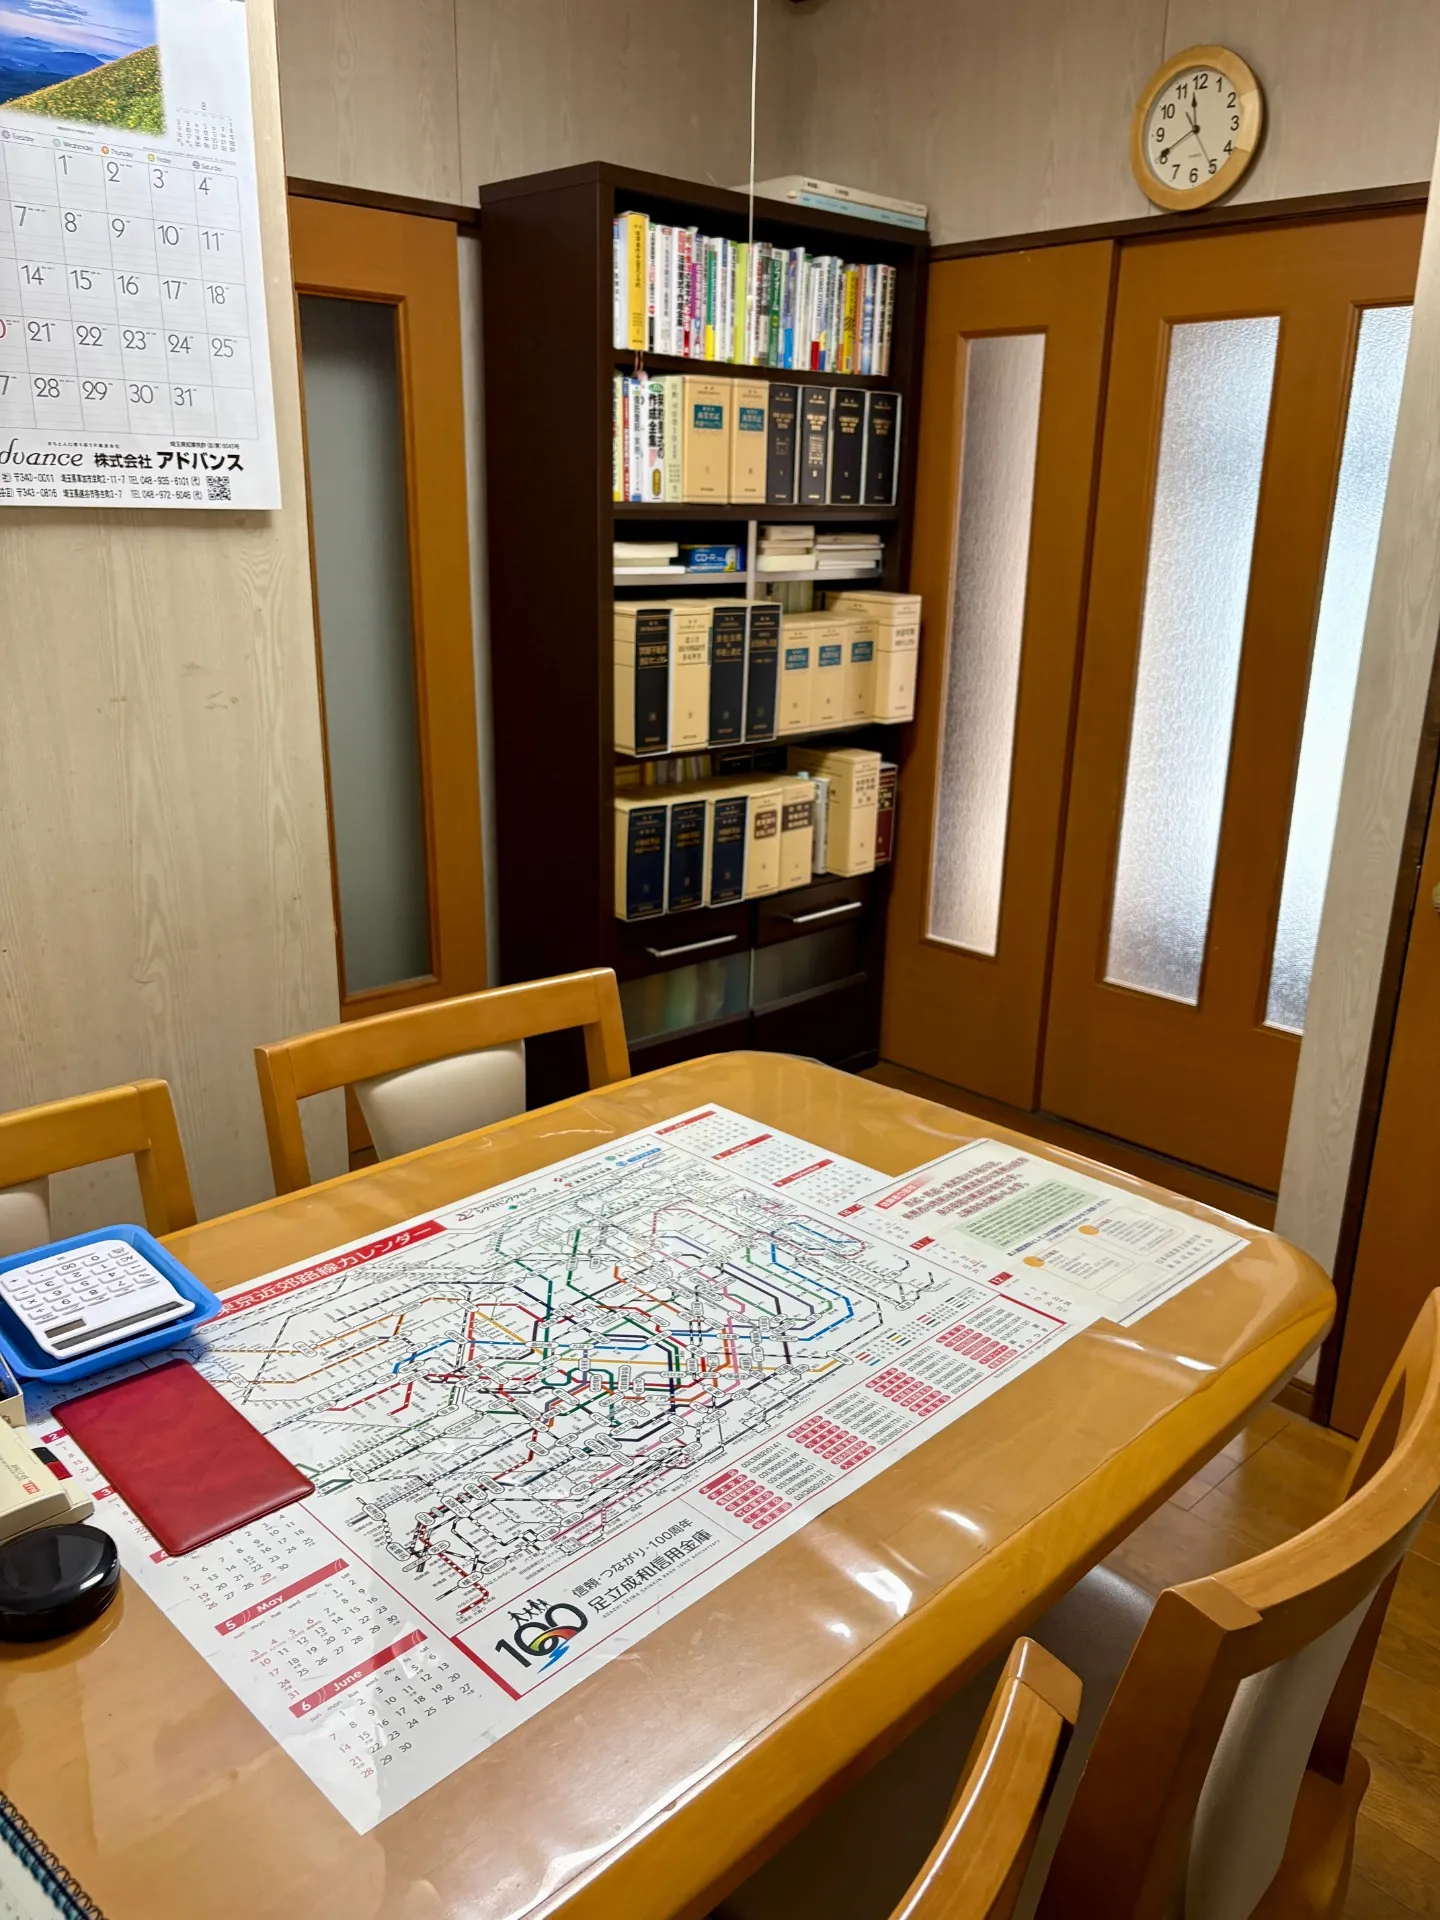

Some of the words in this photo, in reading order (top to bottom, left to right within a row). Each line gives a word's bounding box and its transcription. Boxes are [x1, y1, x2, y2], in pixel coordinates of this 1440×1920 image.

[1176, 83, 1188, 100] 11
[1192, 73, 1209, 90] 12
[1215, 77, 1223, 92] 1
[1227, 92, 1236, 108] 2
[1160, 103, 1175, 120] 10
[1230, 115, 1240, 131] 3
[1156, 127, 1165, 143] 9
[1223, 140, 1233, 155] 4
[58, 154, 68, 175] 1
[107, 161, 120, 183] 2
[153, 168, 165, 189] 3
[198, 177, 210, 196] 4
[1172, 164, 1180, 180] 7
[1189, 168, 1198, 183] 6
[1208, 158, 1218, 174] 5
[14, 205, 27, 227] 7
[64, 212, 78, 233] 8
[111, 218, 126, 238] 9
[157, 224, 180, 246] 10
[201, 231, 220, 251] 11
[20, 265, 45, 285] 14
[70, 269, 92, 290] 15
[117, 275, 139, 295] 16
[163, 280, 181, 299] 17
[206, 285, 226, 305] 18
[27, 321, 51, 343] 21
[76, 325, 104, 346] 22
[122, 329, 147, 350] 23
[167, 334, 192, 354] 24
[211, 338, 234, 358] 25
[33, 377, 61, 398] 28
[82, 381, 108, 401] 29
[128, 384, 154, 404] 30
[173, 387, 193, 407] 31
[94, 452, 153, 469] 株式会社
[156, 451, 244, 471] アドバンス
[61, 1262, 77, 1271] 00
[217, 1227, 432, 1318] 東京近郊路線カレンダー
[48, 1433, 59, 1441] 2
[100, 1488, 112, 1496] 3
[540, 1528, 558, 1540] 川崎
[160, 1550, 168, 1558] 4
[189, 1583, 202, 1591] 12
[207, 1573, 219, 1582] 13
[225, 1564, 237, 1572] 14
[243, 1555, 254, 1563] 15
[260, 1546, 272, 1554] 16
[277, 1537, 288, 1545] 17
[294, 1528, 305, 1536] 18
[587, 1528, 713, 1614] 足立成和信用金庫
[226, 1620, 237, 1630] 5
[256, 1594, 284, 1613] May
[259, 1657, 272, 1667] 10
[277, 1647, 290, 1656] 11
[296, 1636, 309, 1646] 12
[314, 1626, 326, 1635] 13
[332, 1616, 344, 1625] 14
[349, 1605, 361, 1615] 15
[366, 1596, 378, 1605] 16
[301, 1701, 312, 1711] 6
[333, 1670, 363, 1692] June
[357, 1698, 366, 1706] 2
[375, 1686, 384, 1694] 3
[411, 1664, 419, 1672] 5
[329, 1732, 337, 1741] 7
[349, 1721, 358, 1729] 8
[368, 1709, 376, 1717] 9
[384, 1696, 397, 1706] 10
[402, 1685, 414, 1694] 11
[420, 1673, 432, 1682] 12
[437, 1662, 450, 1672] 13
[339, 1743, 352, 1754] 14
[358, 1731, 371, 1741] 15
[377, 1718, 390, 1729] 16
[395, 1706, 406, 1717] 17
[413, 1695, 426, 1705] 18
[431, 1683, 443, 1693] 19
[448, 1672, 461, 1682] 20
[350, 1756, 362, 1766] 21
[369, 1742, 382, 1754] 22
[387, 1730, 401, 1741] 23
[405, 1718, 419, 1729] 24
[424, 1706, 437, 1717] 25
[441, 1694, 455, 1705] 26
[459, 1682, 471, 1694] 27
[360, 1768, 375, 1779] 28
[380, 1754, 393, 1766] 29
[399, 1742, 412, 1753] 30
